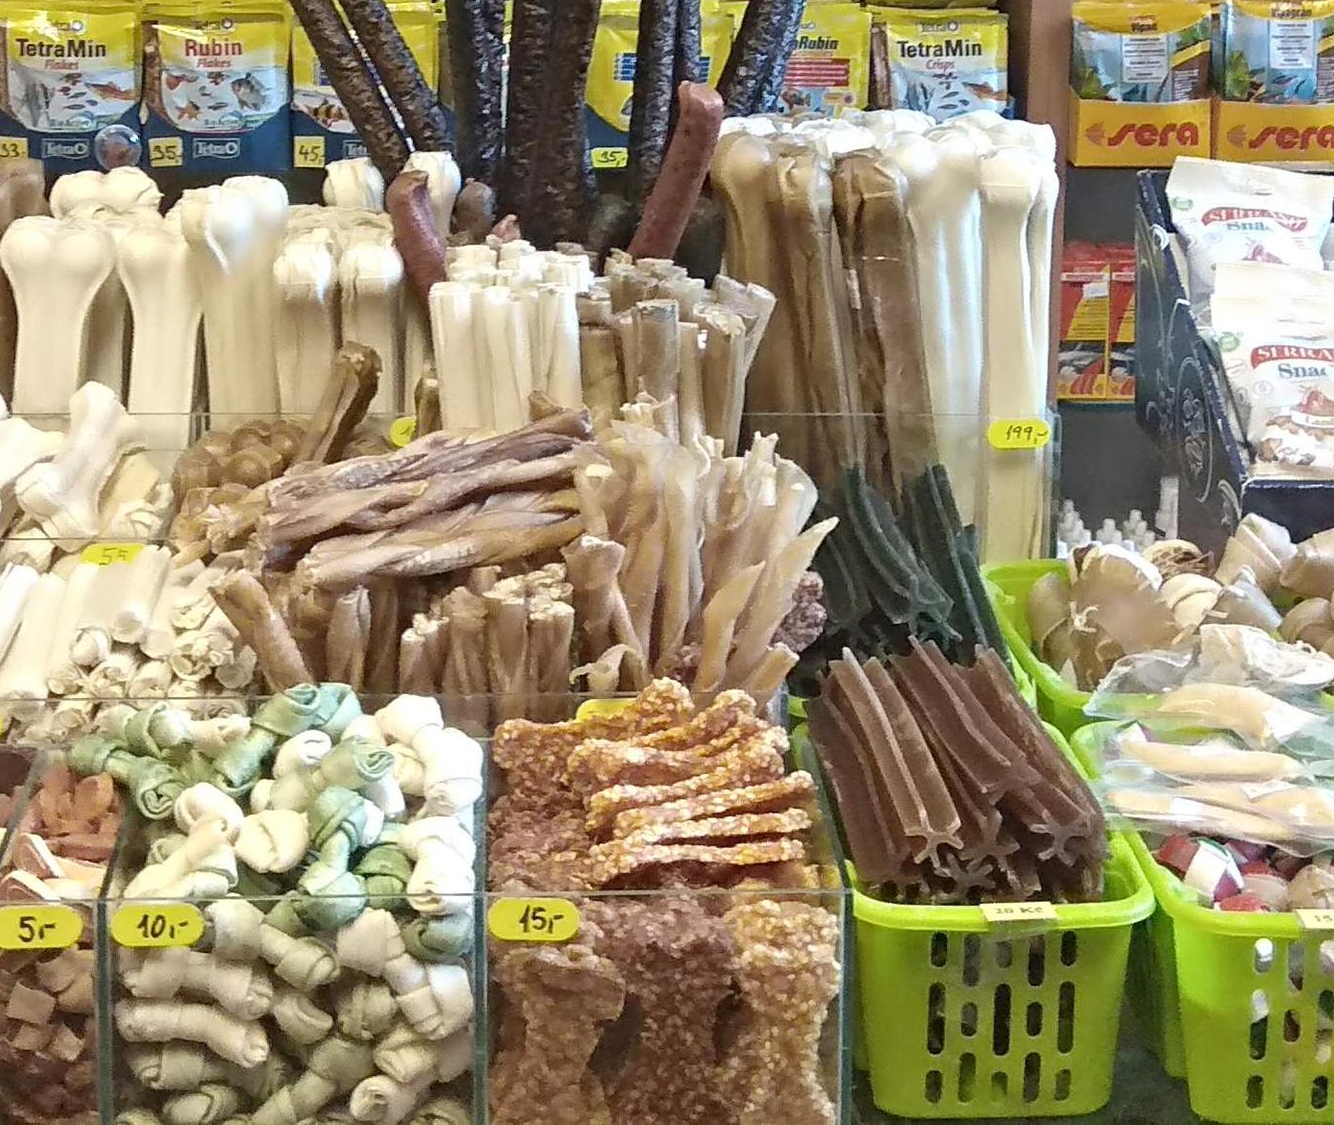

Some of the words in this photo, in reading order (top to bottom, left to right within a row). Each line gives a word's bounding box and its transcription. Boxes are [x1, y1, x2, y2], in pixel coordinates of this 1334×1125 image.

[16, 38, 107, 58] TetraMin
[185, 39, 243, 57] Rubin
[896, 38, 983, 59] TetraMin
[45, 58, 79, 71] Flakes
[197, 57, 231, 69] Flakes
[926, 59, 955, 71] Crisps
[1107, 122, 1199, 148] sera
